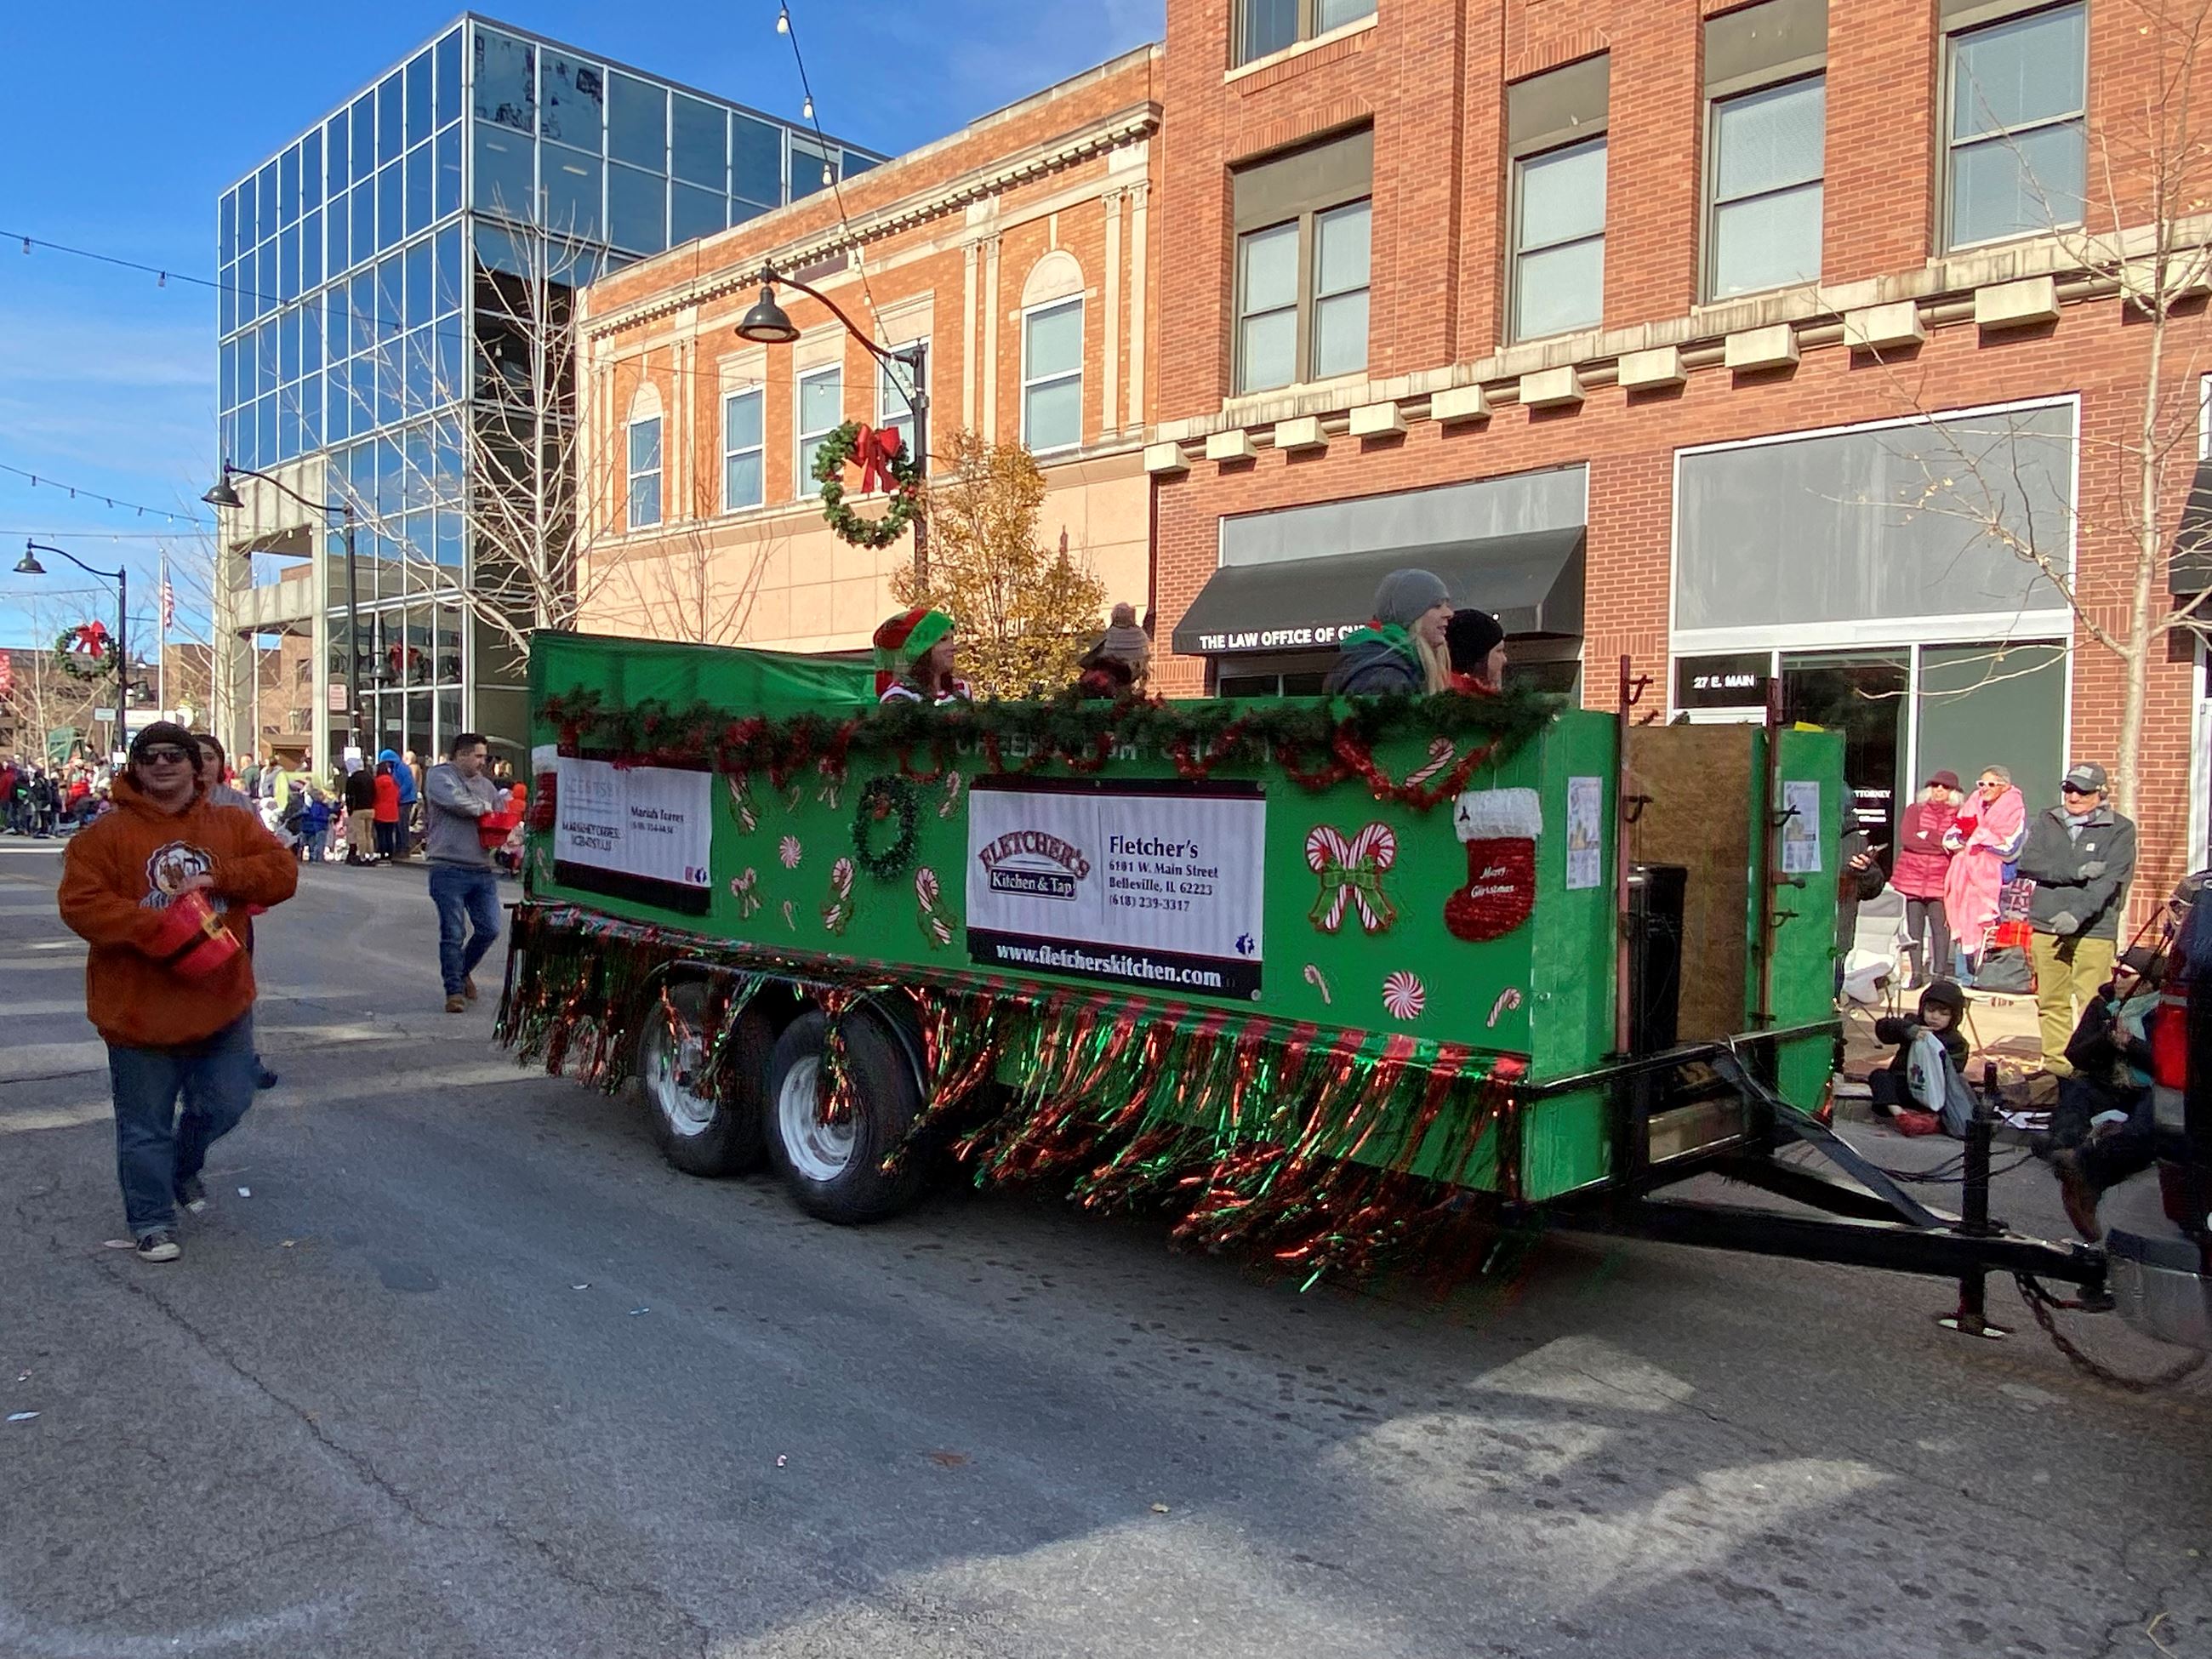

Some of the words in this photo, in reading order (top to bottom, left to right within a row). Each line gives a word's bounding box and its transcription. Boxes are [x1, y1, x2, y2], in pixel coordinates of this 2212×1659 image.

[1200, 635, 1226, 649] THE
[1228, 632, 1258, 647] LAW
[1261, 629, 1311, 647] OFFICE
[1314, 627, 1335, 642] OF
[1693, 676, 1709, 688] 27
[1711, 676, 1723, 687] E.
[1725, 674, 1755, 687] MAIN
[1852, 790, 1891, 798] TTORNEY
[978, 830, 1091, 881] FLETCHER'S
[1109, 835, 1199, 859] Fletcher's
[1137, 861, 1153, 874] W.
[1154, 863, 1183, 876] Main
[1185, 864, 1219, 879] Street
[992, 871, 1036, 890] Kitchen
[1037, 876, 1050, 892] &
[1050, 877, 1073, 898] Tap
[1109, 876, 1164, 893] Belleville,
[1166, 881, 1177, 893] IL
[1179, 882, 1213, 896] 62223
[1109, 893, 1137, 908] (618)
[1138, 897, 1191, 912] 239-3317
[996, 944, 1222, 987] www.fletcherskitchen.com
